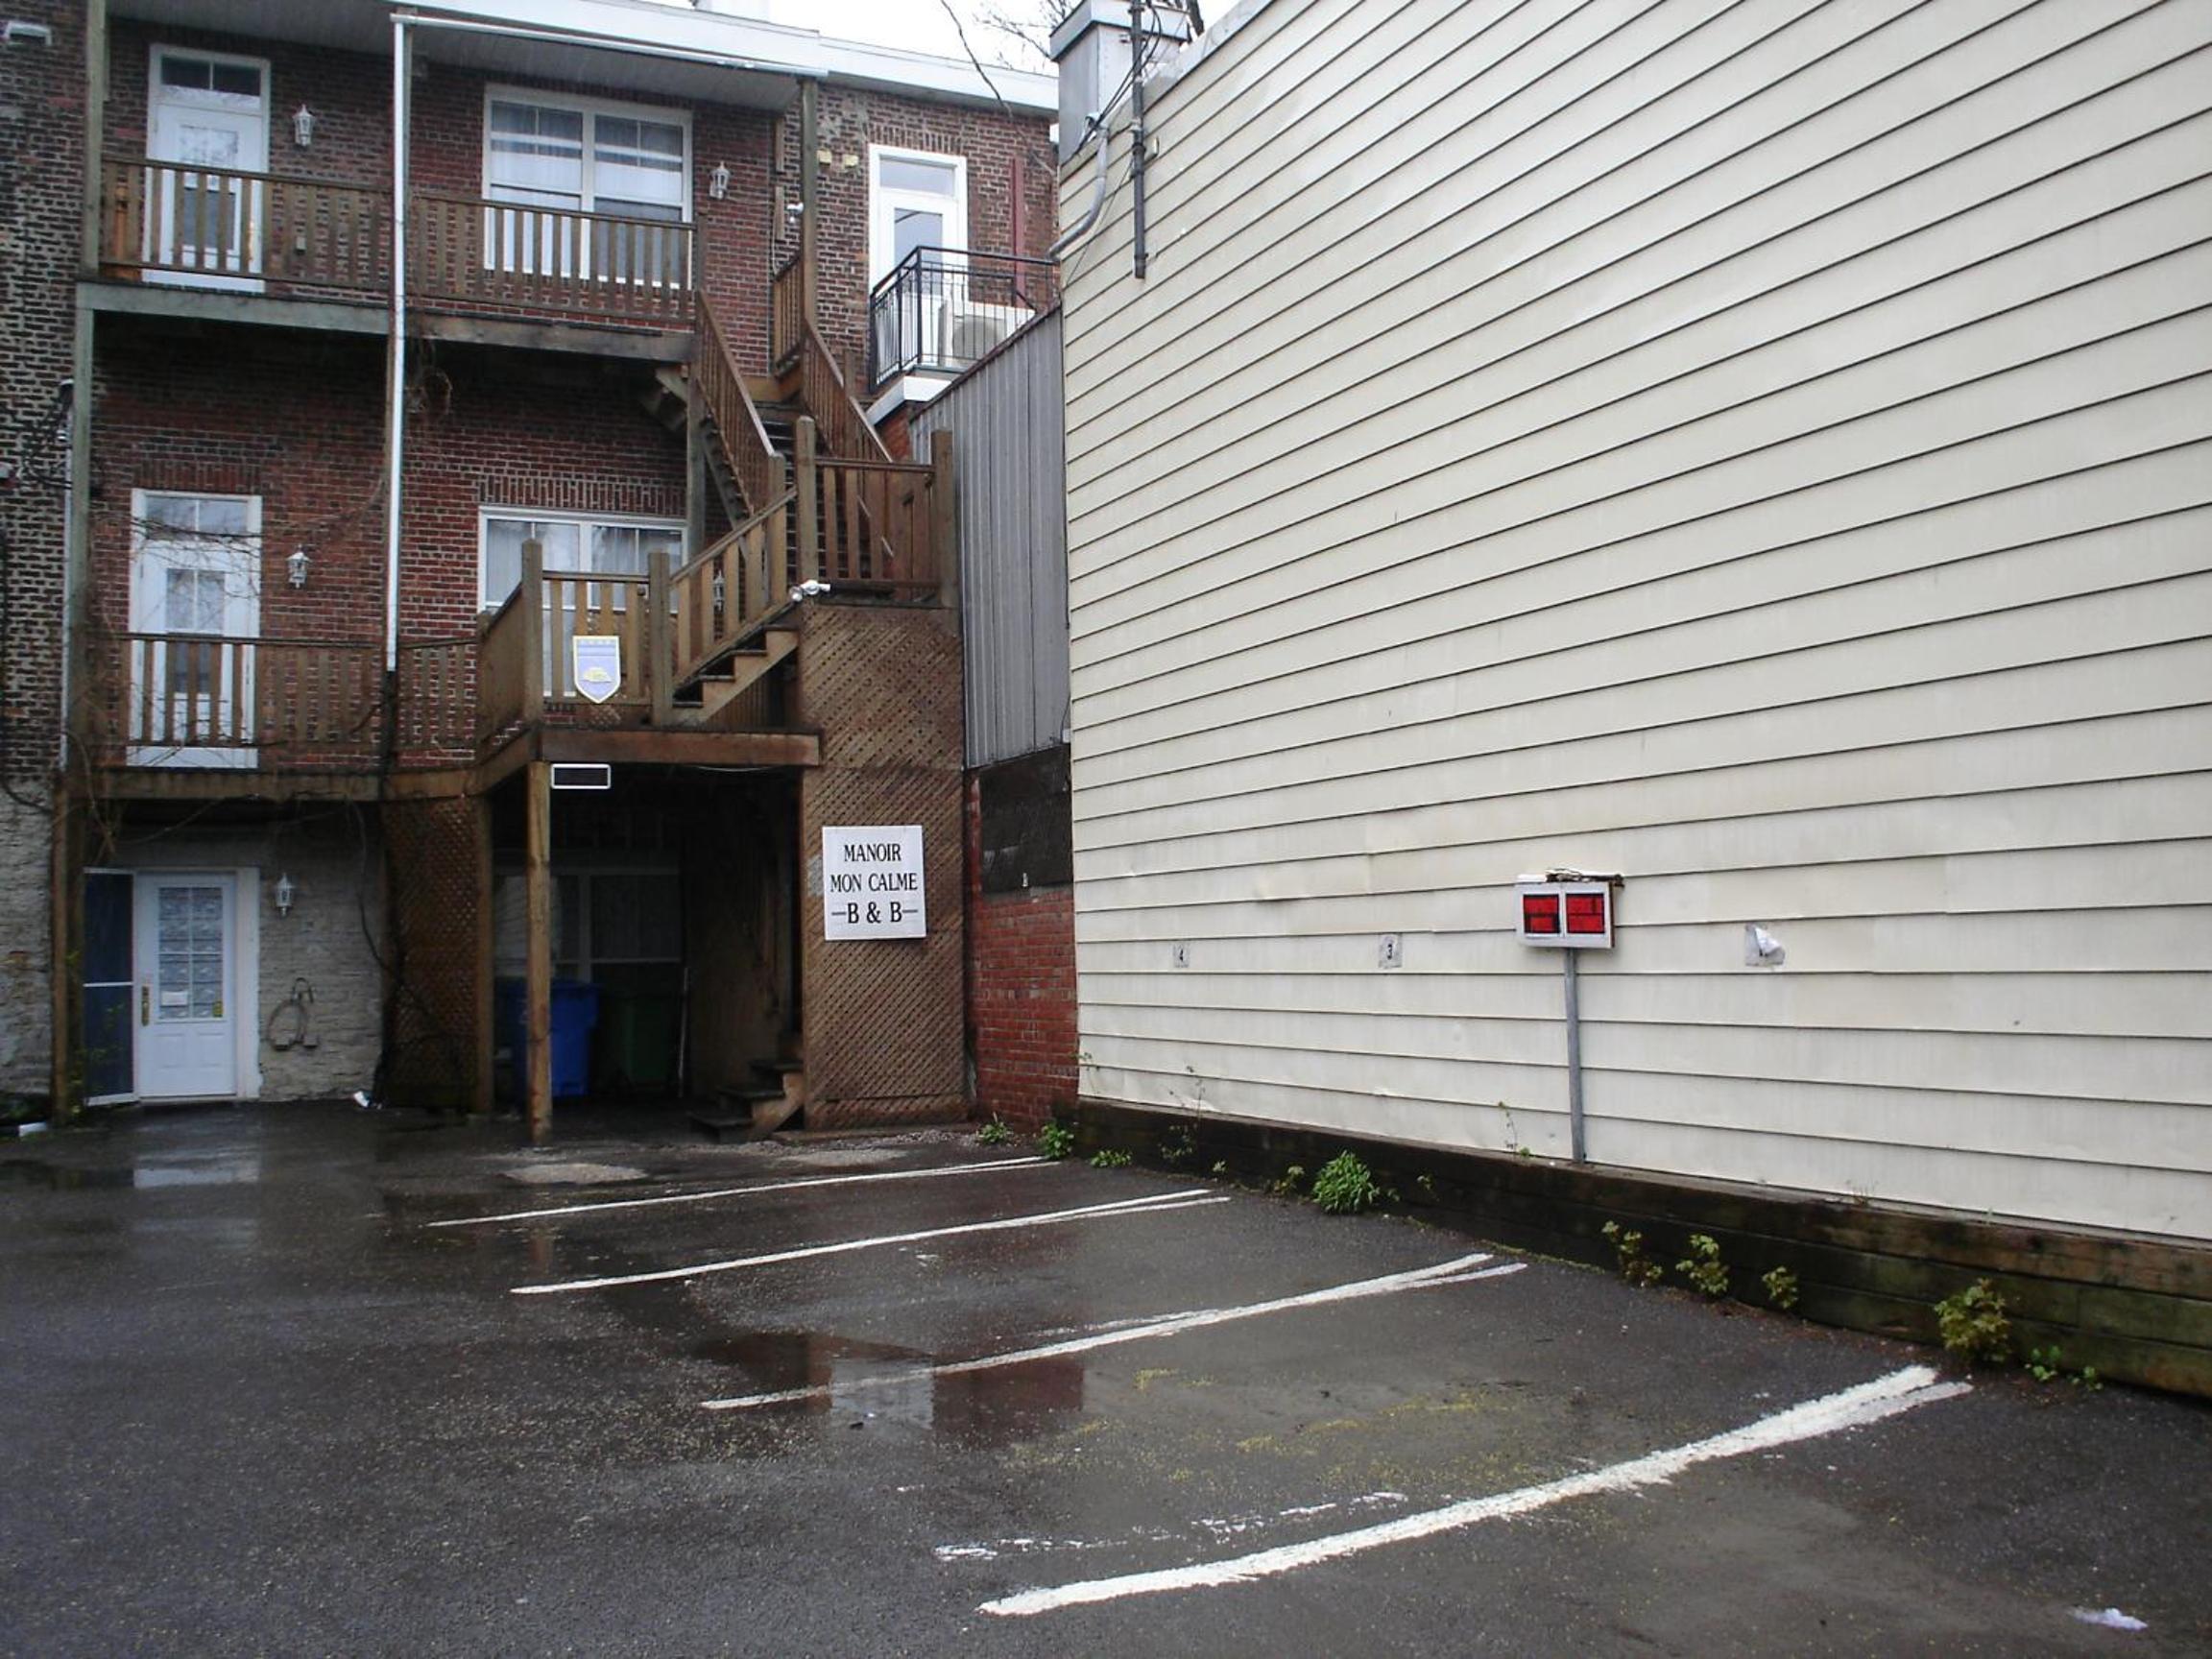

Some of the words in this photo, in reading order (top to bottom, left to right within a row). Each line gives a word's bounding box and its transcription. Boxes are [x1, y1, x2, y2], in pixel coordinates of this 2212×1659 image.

[844, 843, 902, 862] MANOIR
[830, 873, 862, 893] MON
[868, 872, 919, 891] CALME
[866, 901, 882, 924] &
